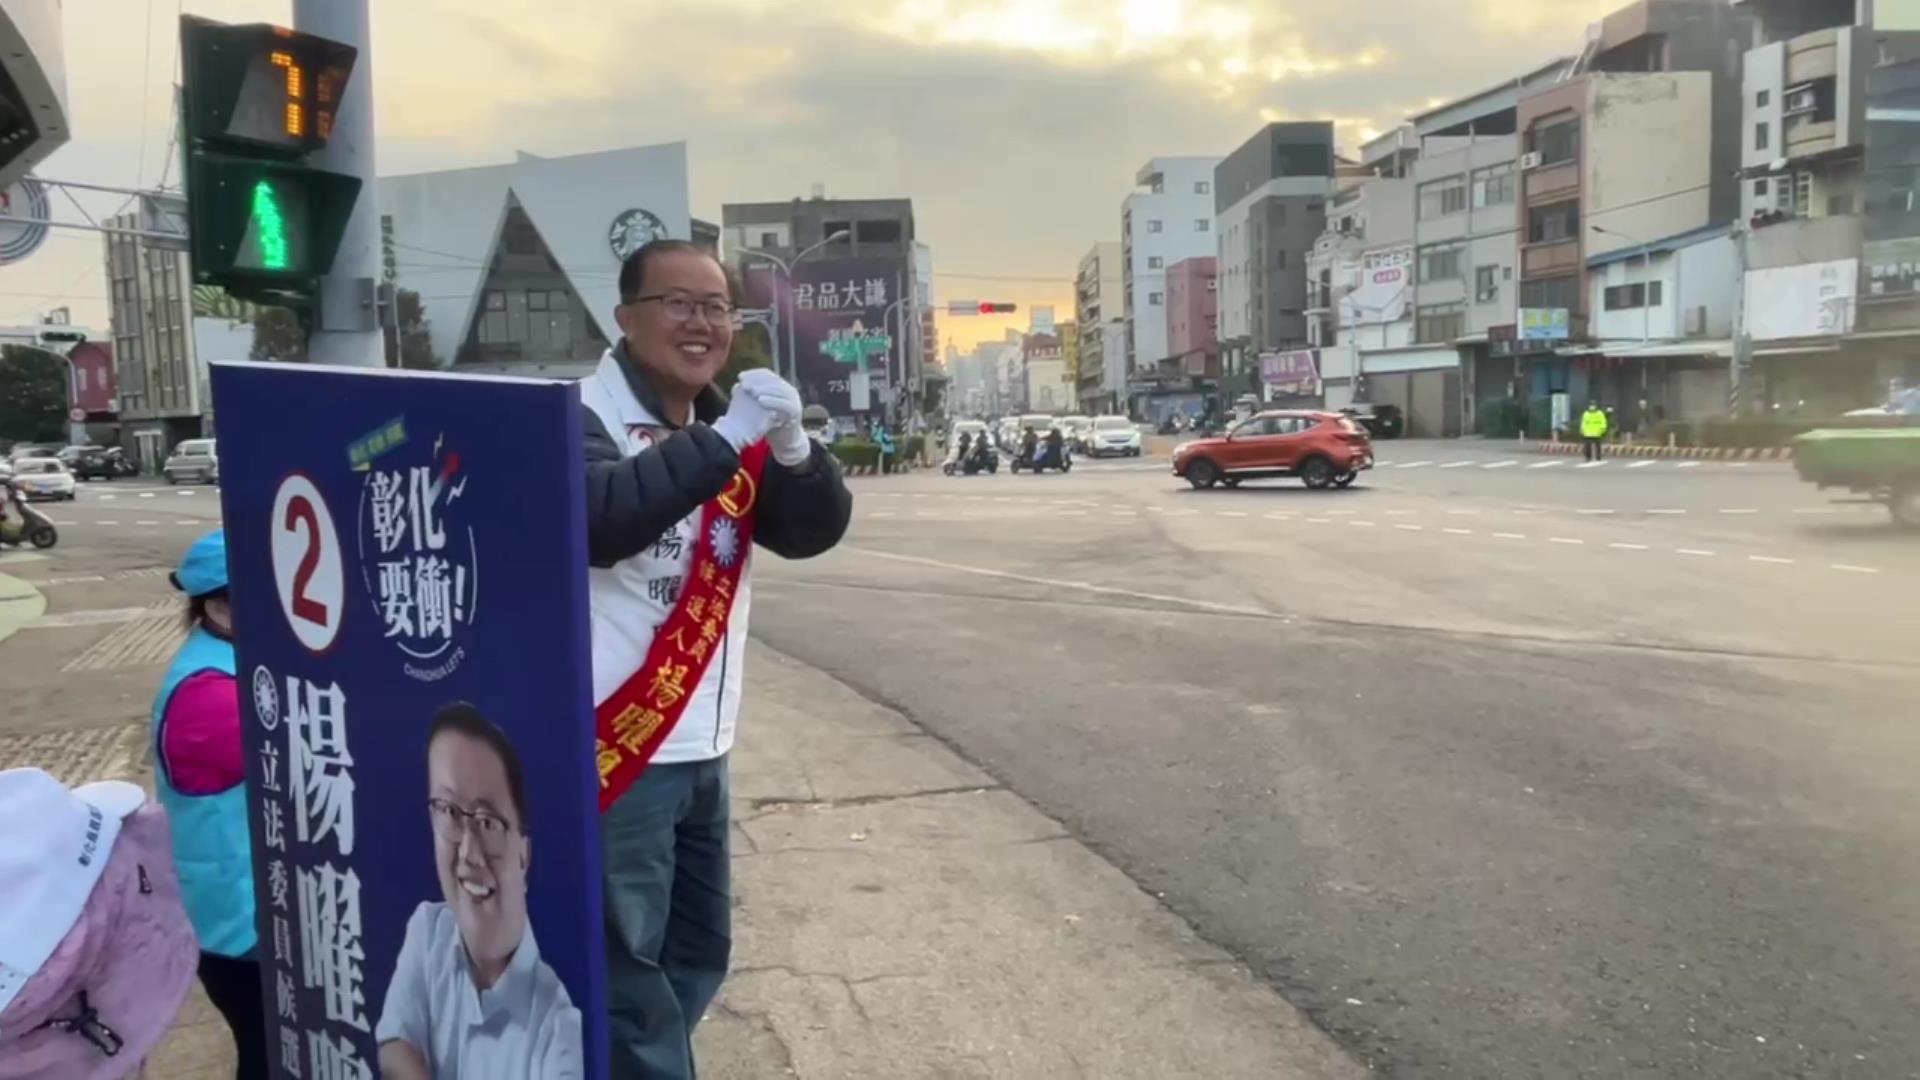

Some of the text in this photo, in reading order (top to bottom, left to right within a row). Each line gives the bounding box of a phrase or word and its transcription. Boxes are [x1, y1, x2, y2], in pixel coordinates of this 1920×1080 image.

[271, 51, 301, 135] 7
[371, 466, 446, 553] 彰化
[285, 495, 328, 628] 2
[377, 554, 465, 639] 要衝!
